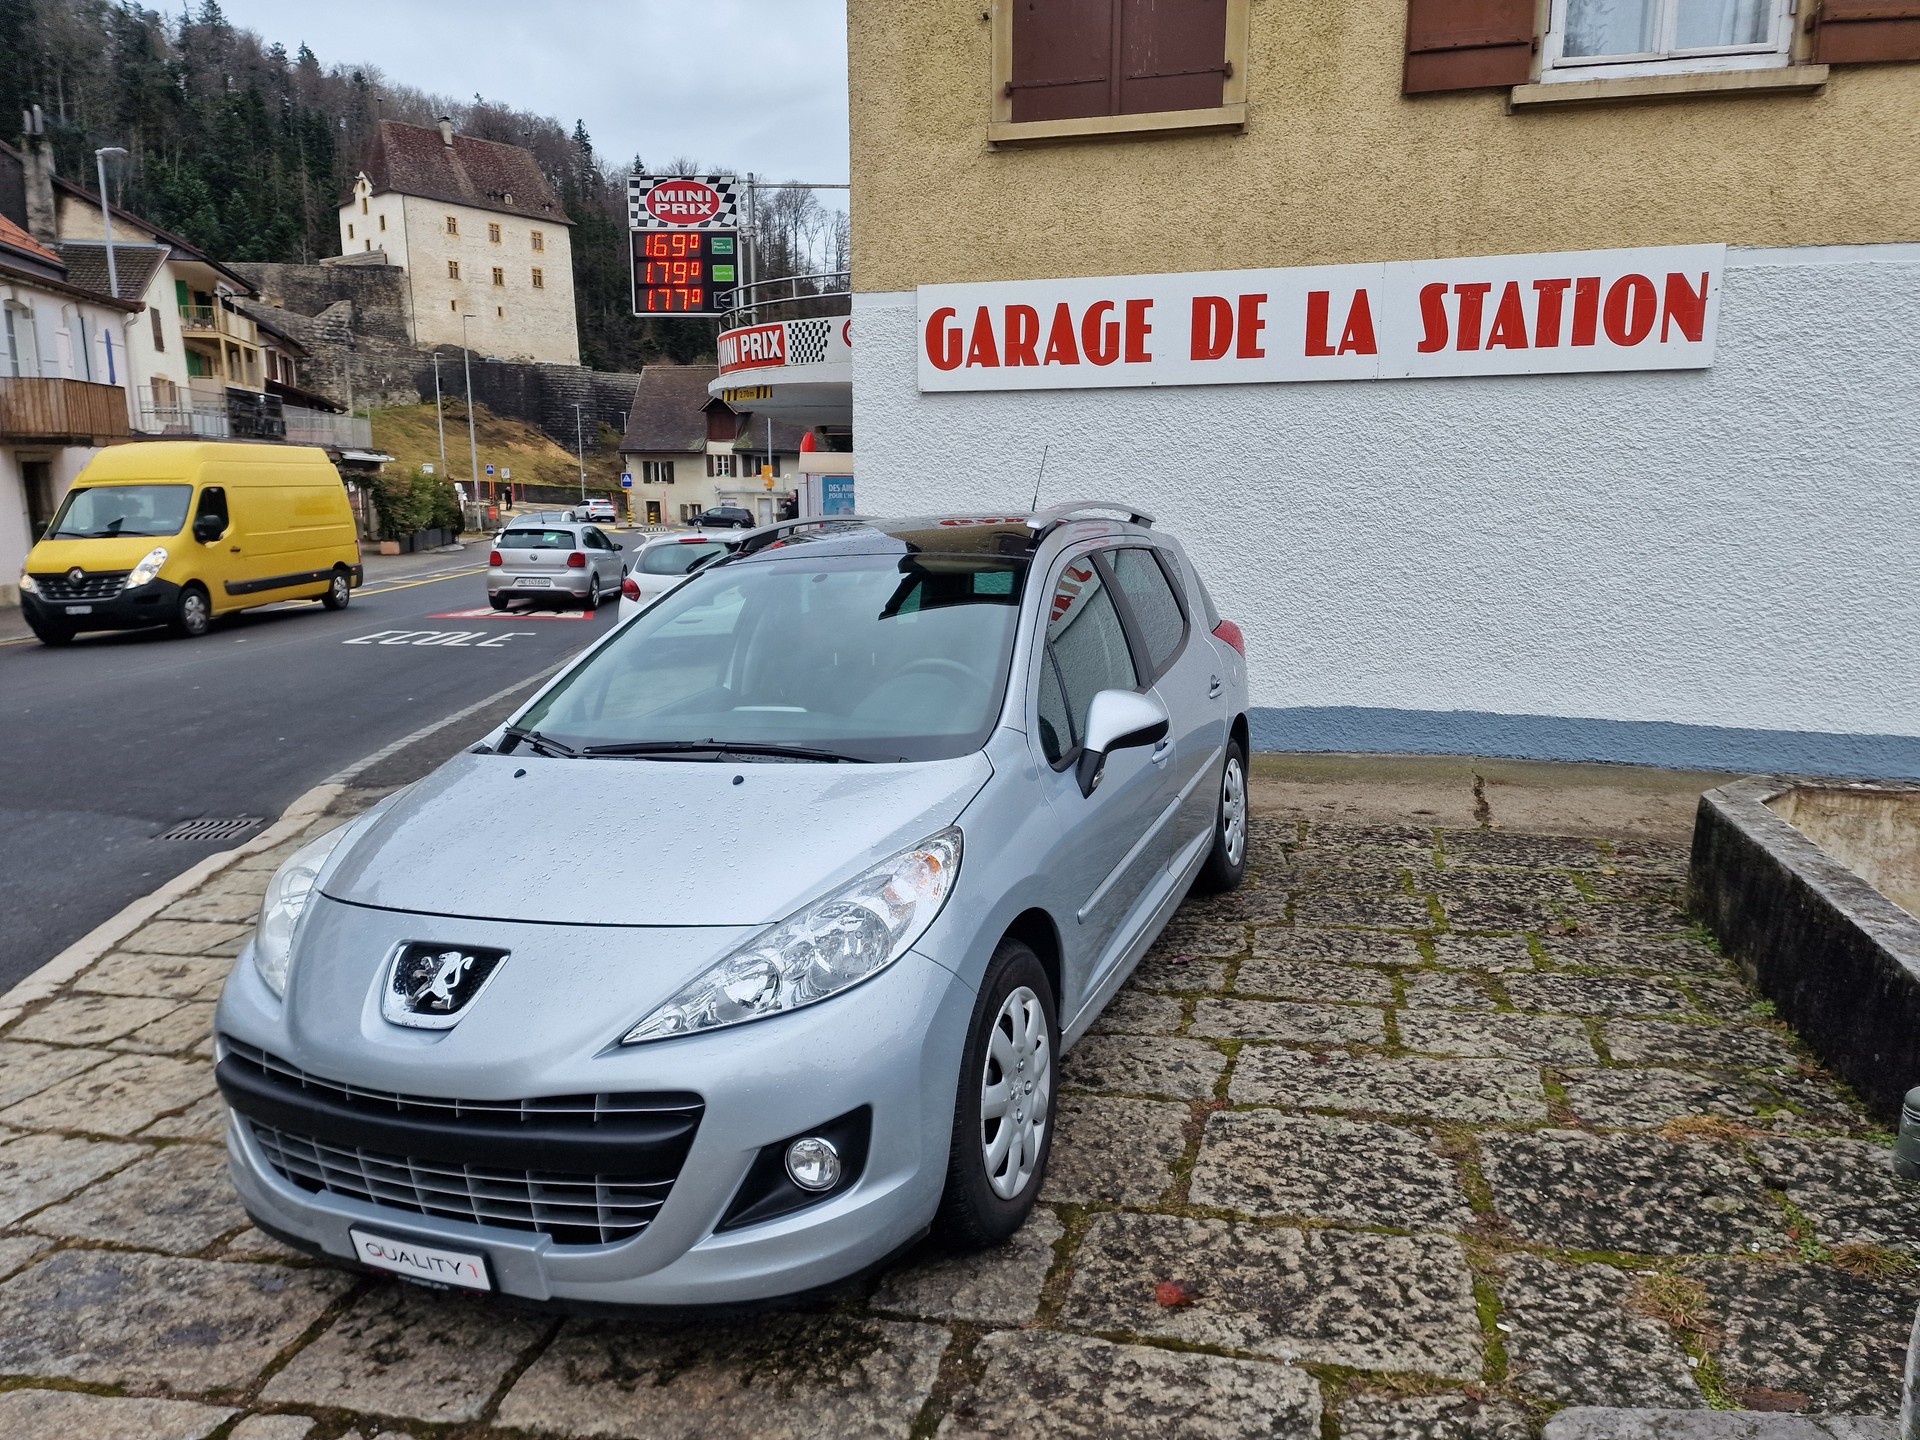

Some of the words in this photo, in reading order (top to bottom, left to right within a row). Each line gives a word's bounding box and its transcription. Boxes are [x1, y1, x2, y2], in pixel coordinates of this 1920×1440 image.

[654, 190, 712, 202] MINI
[655, 203, 713, 215] PRIX
[925, 299, 1154, 371] GARAGE
[1190, 293, 1268, 361] DE
[1305, 289, 1377, 357] LA
[1417, 272, 1709, 353] STATION
[719, 336, 738, 367] MINI
[740, 329, 782, 363] PRIX
[828, 483, 840, 492] DES
[341, 630, 537, 647] ECOLE
